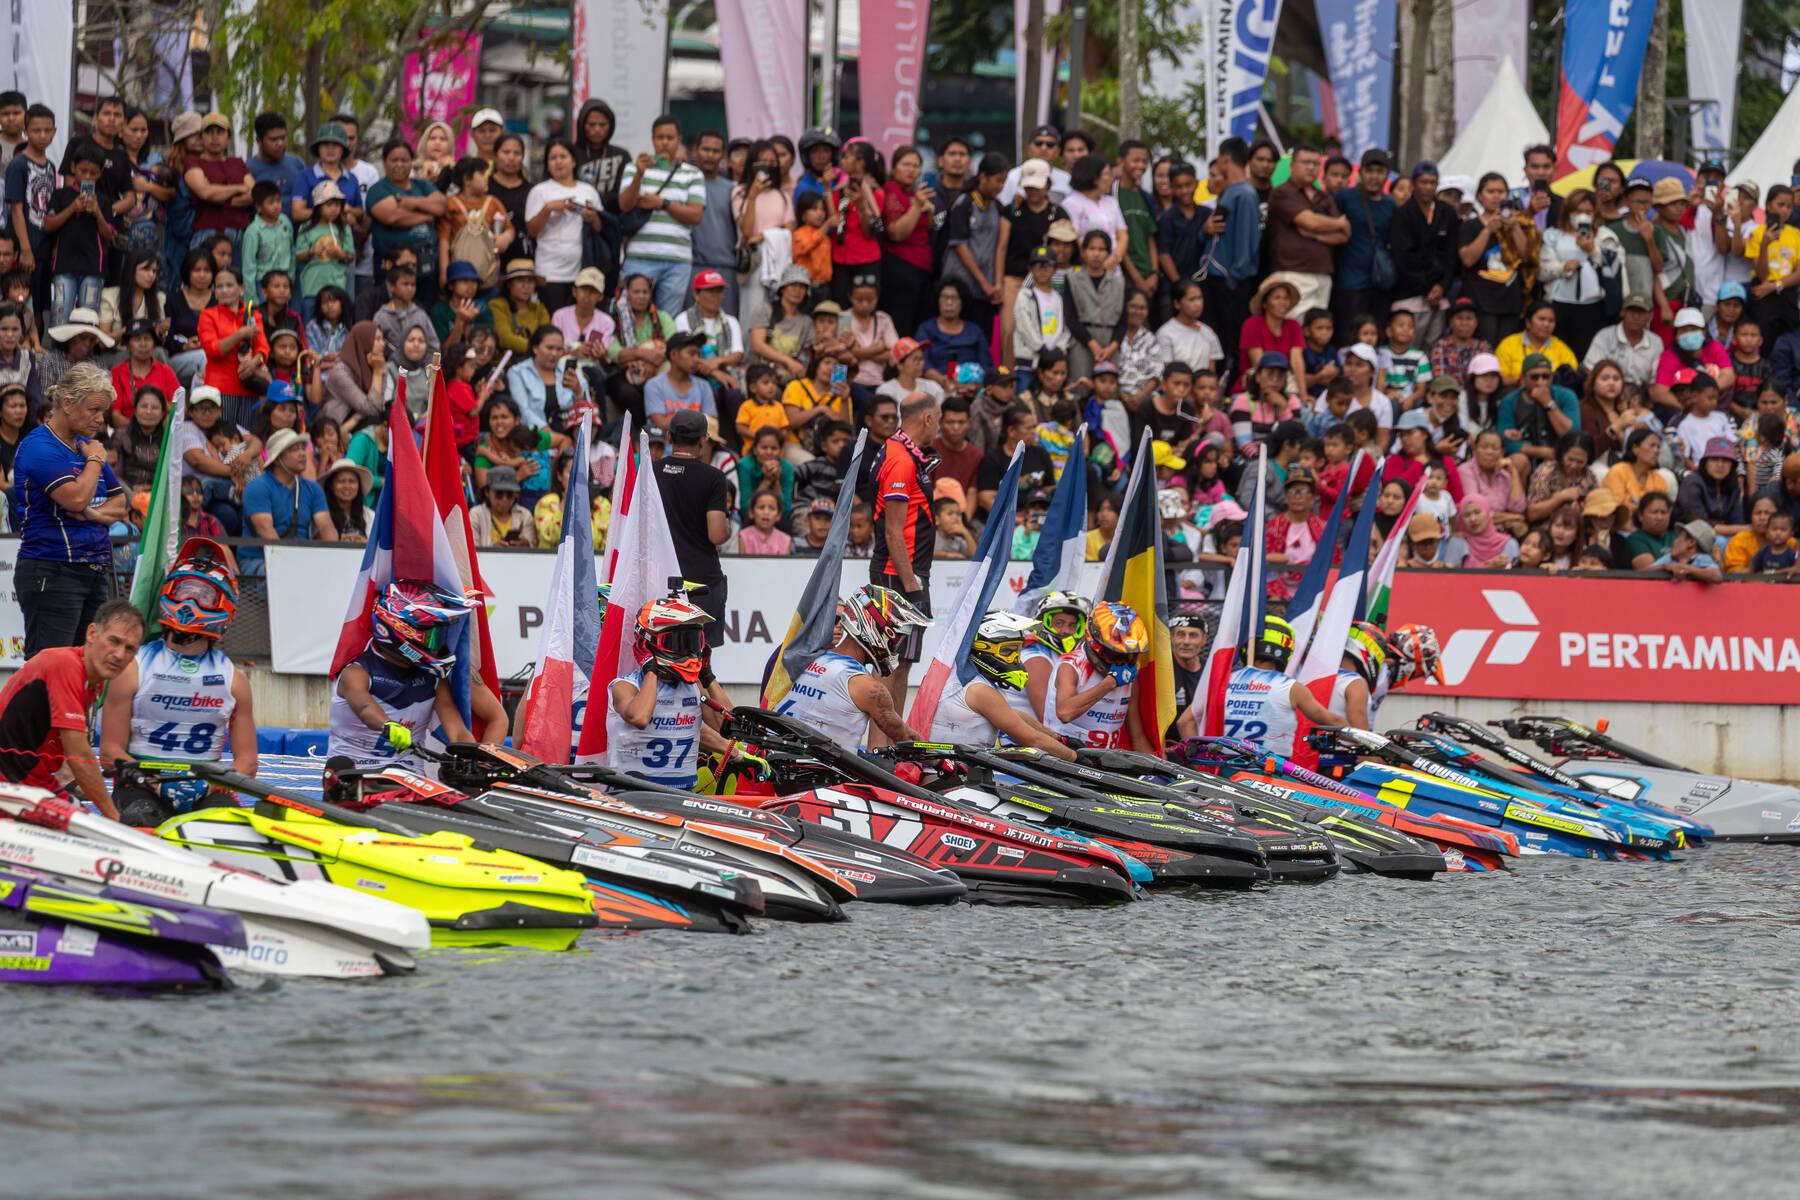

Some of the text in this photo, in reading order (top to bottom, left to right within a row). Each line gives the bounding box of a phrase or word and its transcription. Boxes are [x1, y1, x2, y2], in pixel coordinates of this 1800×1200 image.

[1559, 632, 1800, 672] PERTAMINA
[151, 692, 225, 710] aquabike
[1227, 700, 1264, 710] PORET
[650, 712, 696, 730] quabike
[148, 721, 217, 755] 48
[1224, 720, 1268, 746] 72
[642, 738, 694, 769] 37
[1530, 760, 1556, 777] world
[1248, 780, 1296, 801] FAST
[682, 799, 752, 819] ENDERLI
[895, 796, 997, 832] ProWatercraft
[944, 834, 974, 850] SHOEI
[1002, 828, 1054, 848] JETPILOT
